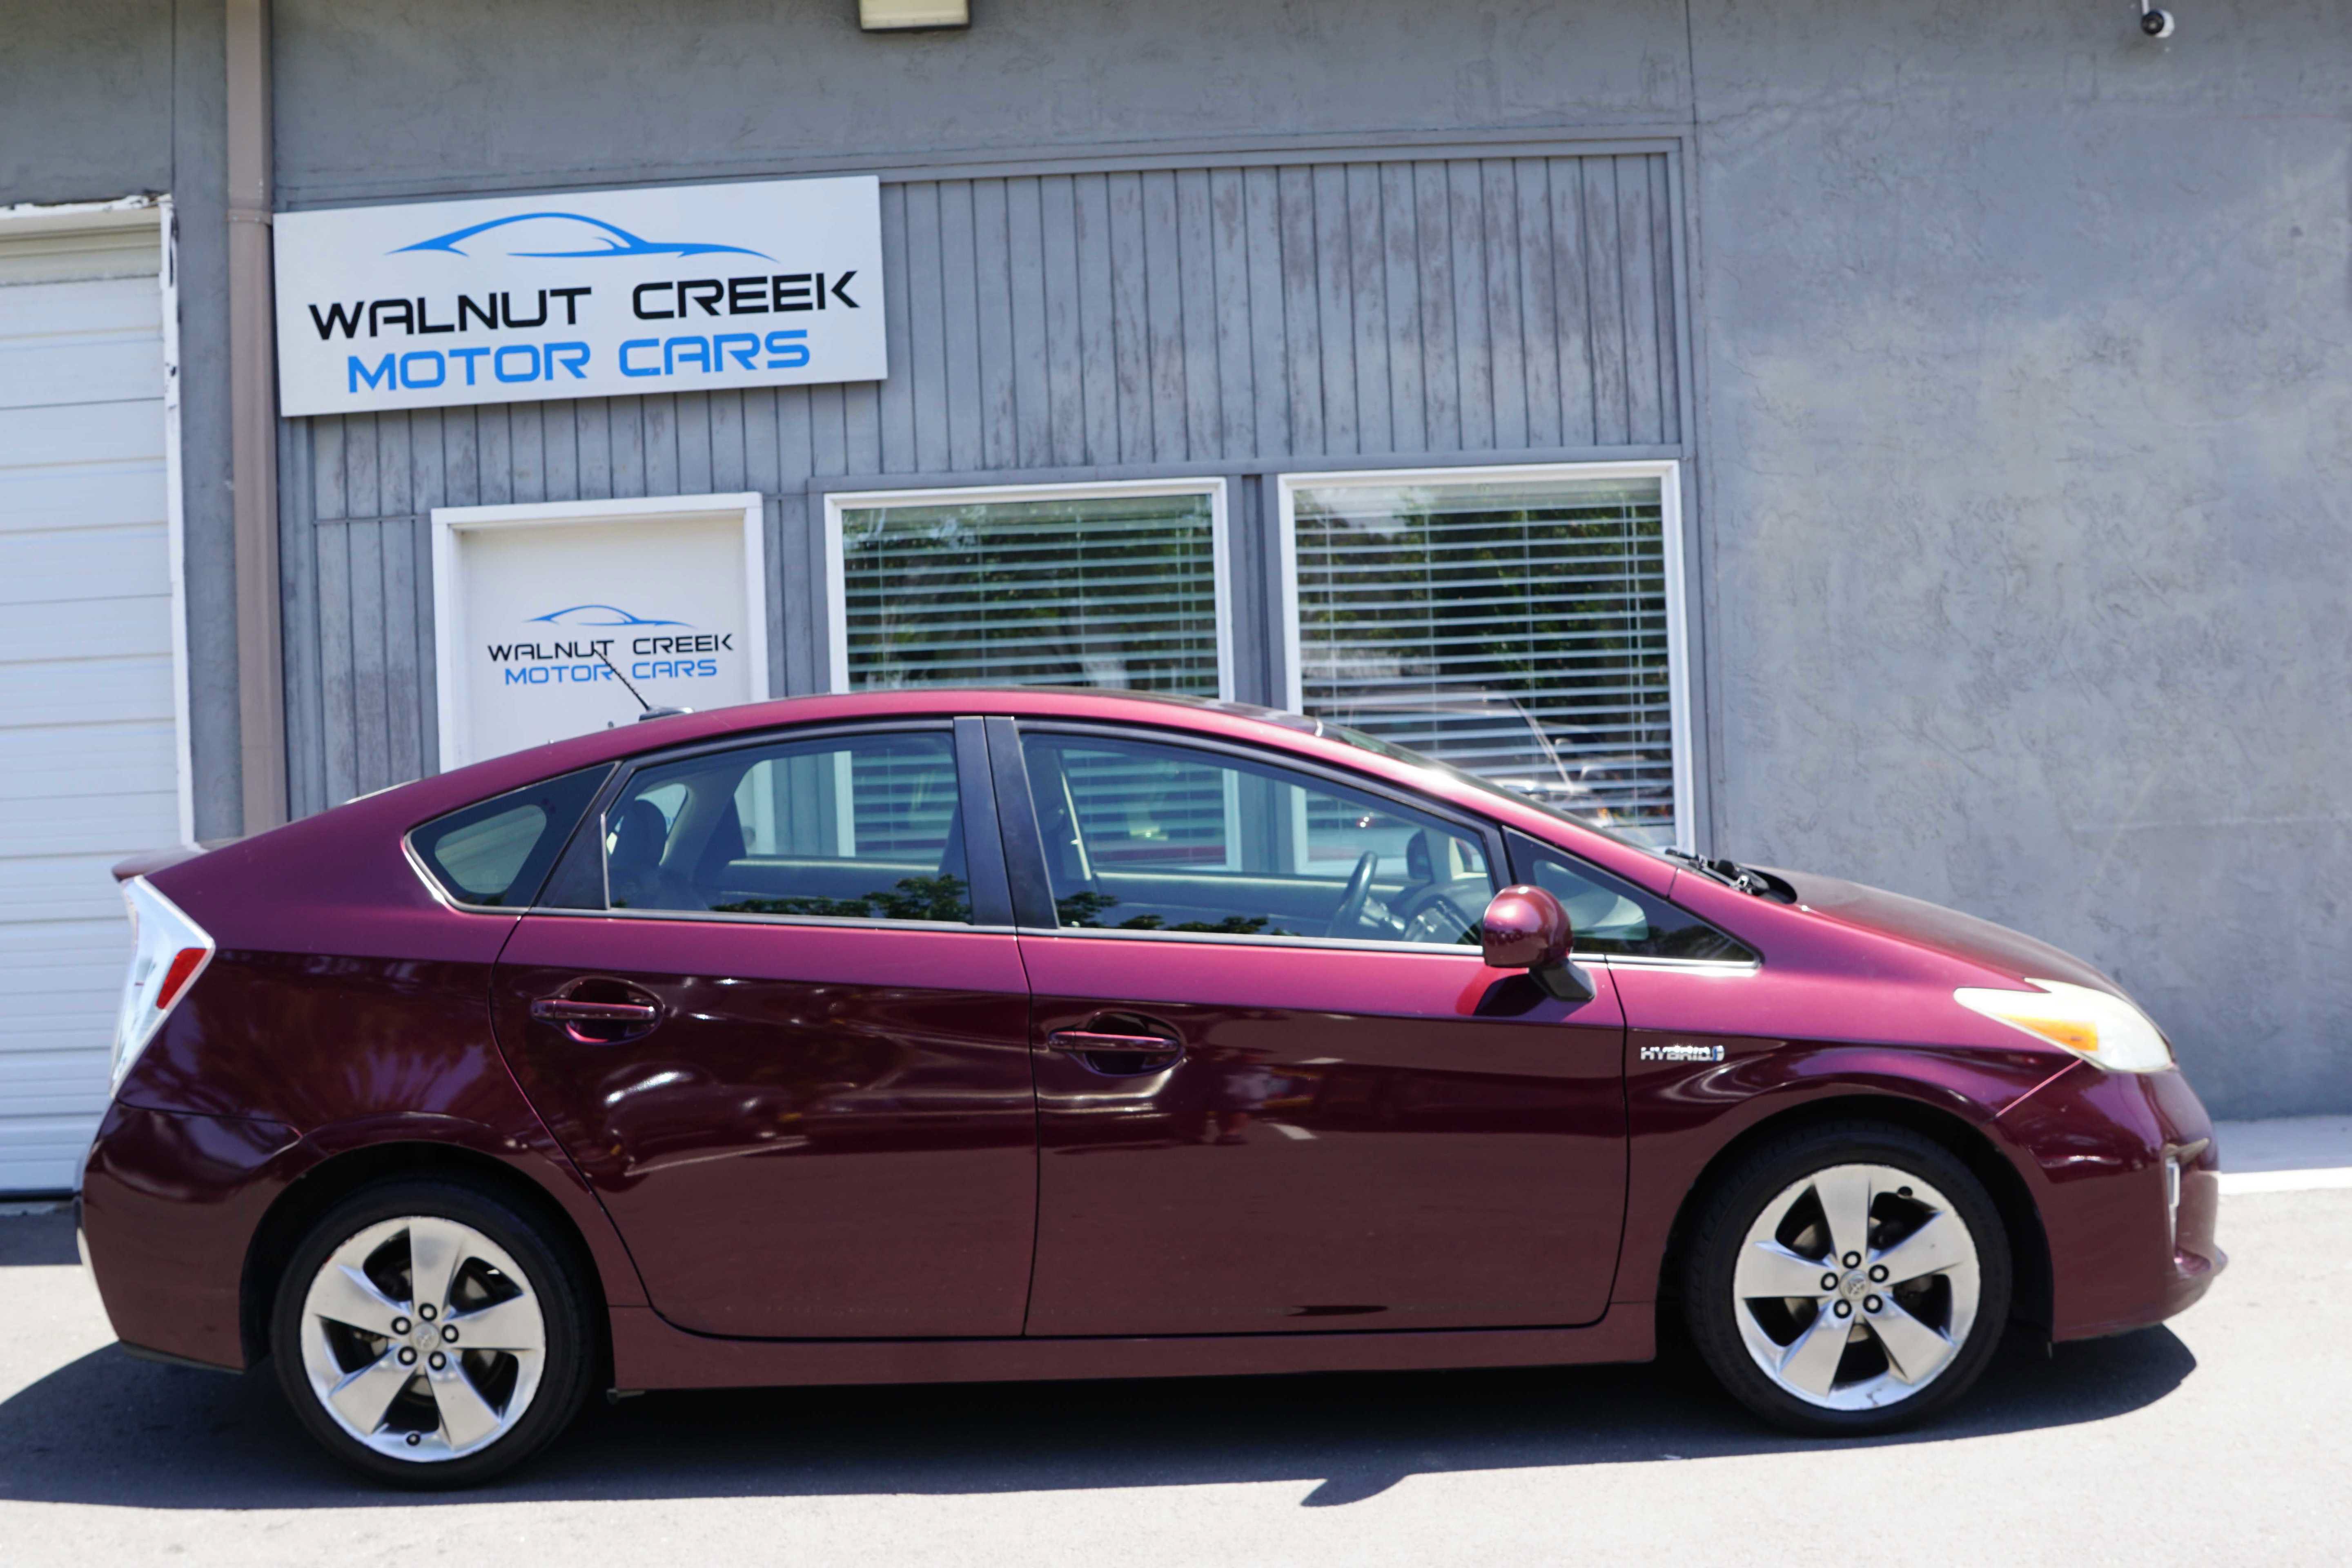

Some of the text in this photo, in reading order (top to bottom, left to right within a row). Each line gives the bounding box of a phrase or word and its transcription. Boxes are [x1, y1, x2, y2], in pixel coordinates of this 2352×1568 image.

[309, 271, 859, 340] WALNUT CREEK
[347, 329, 811, 394] MOTOR CARS
[488, 634, 733, 662] WALNUT CREEK
[505, 658, 718, 686] MOTOR CARS
[1640, 1045, 1711, 1061] HYBRID
